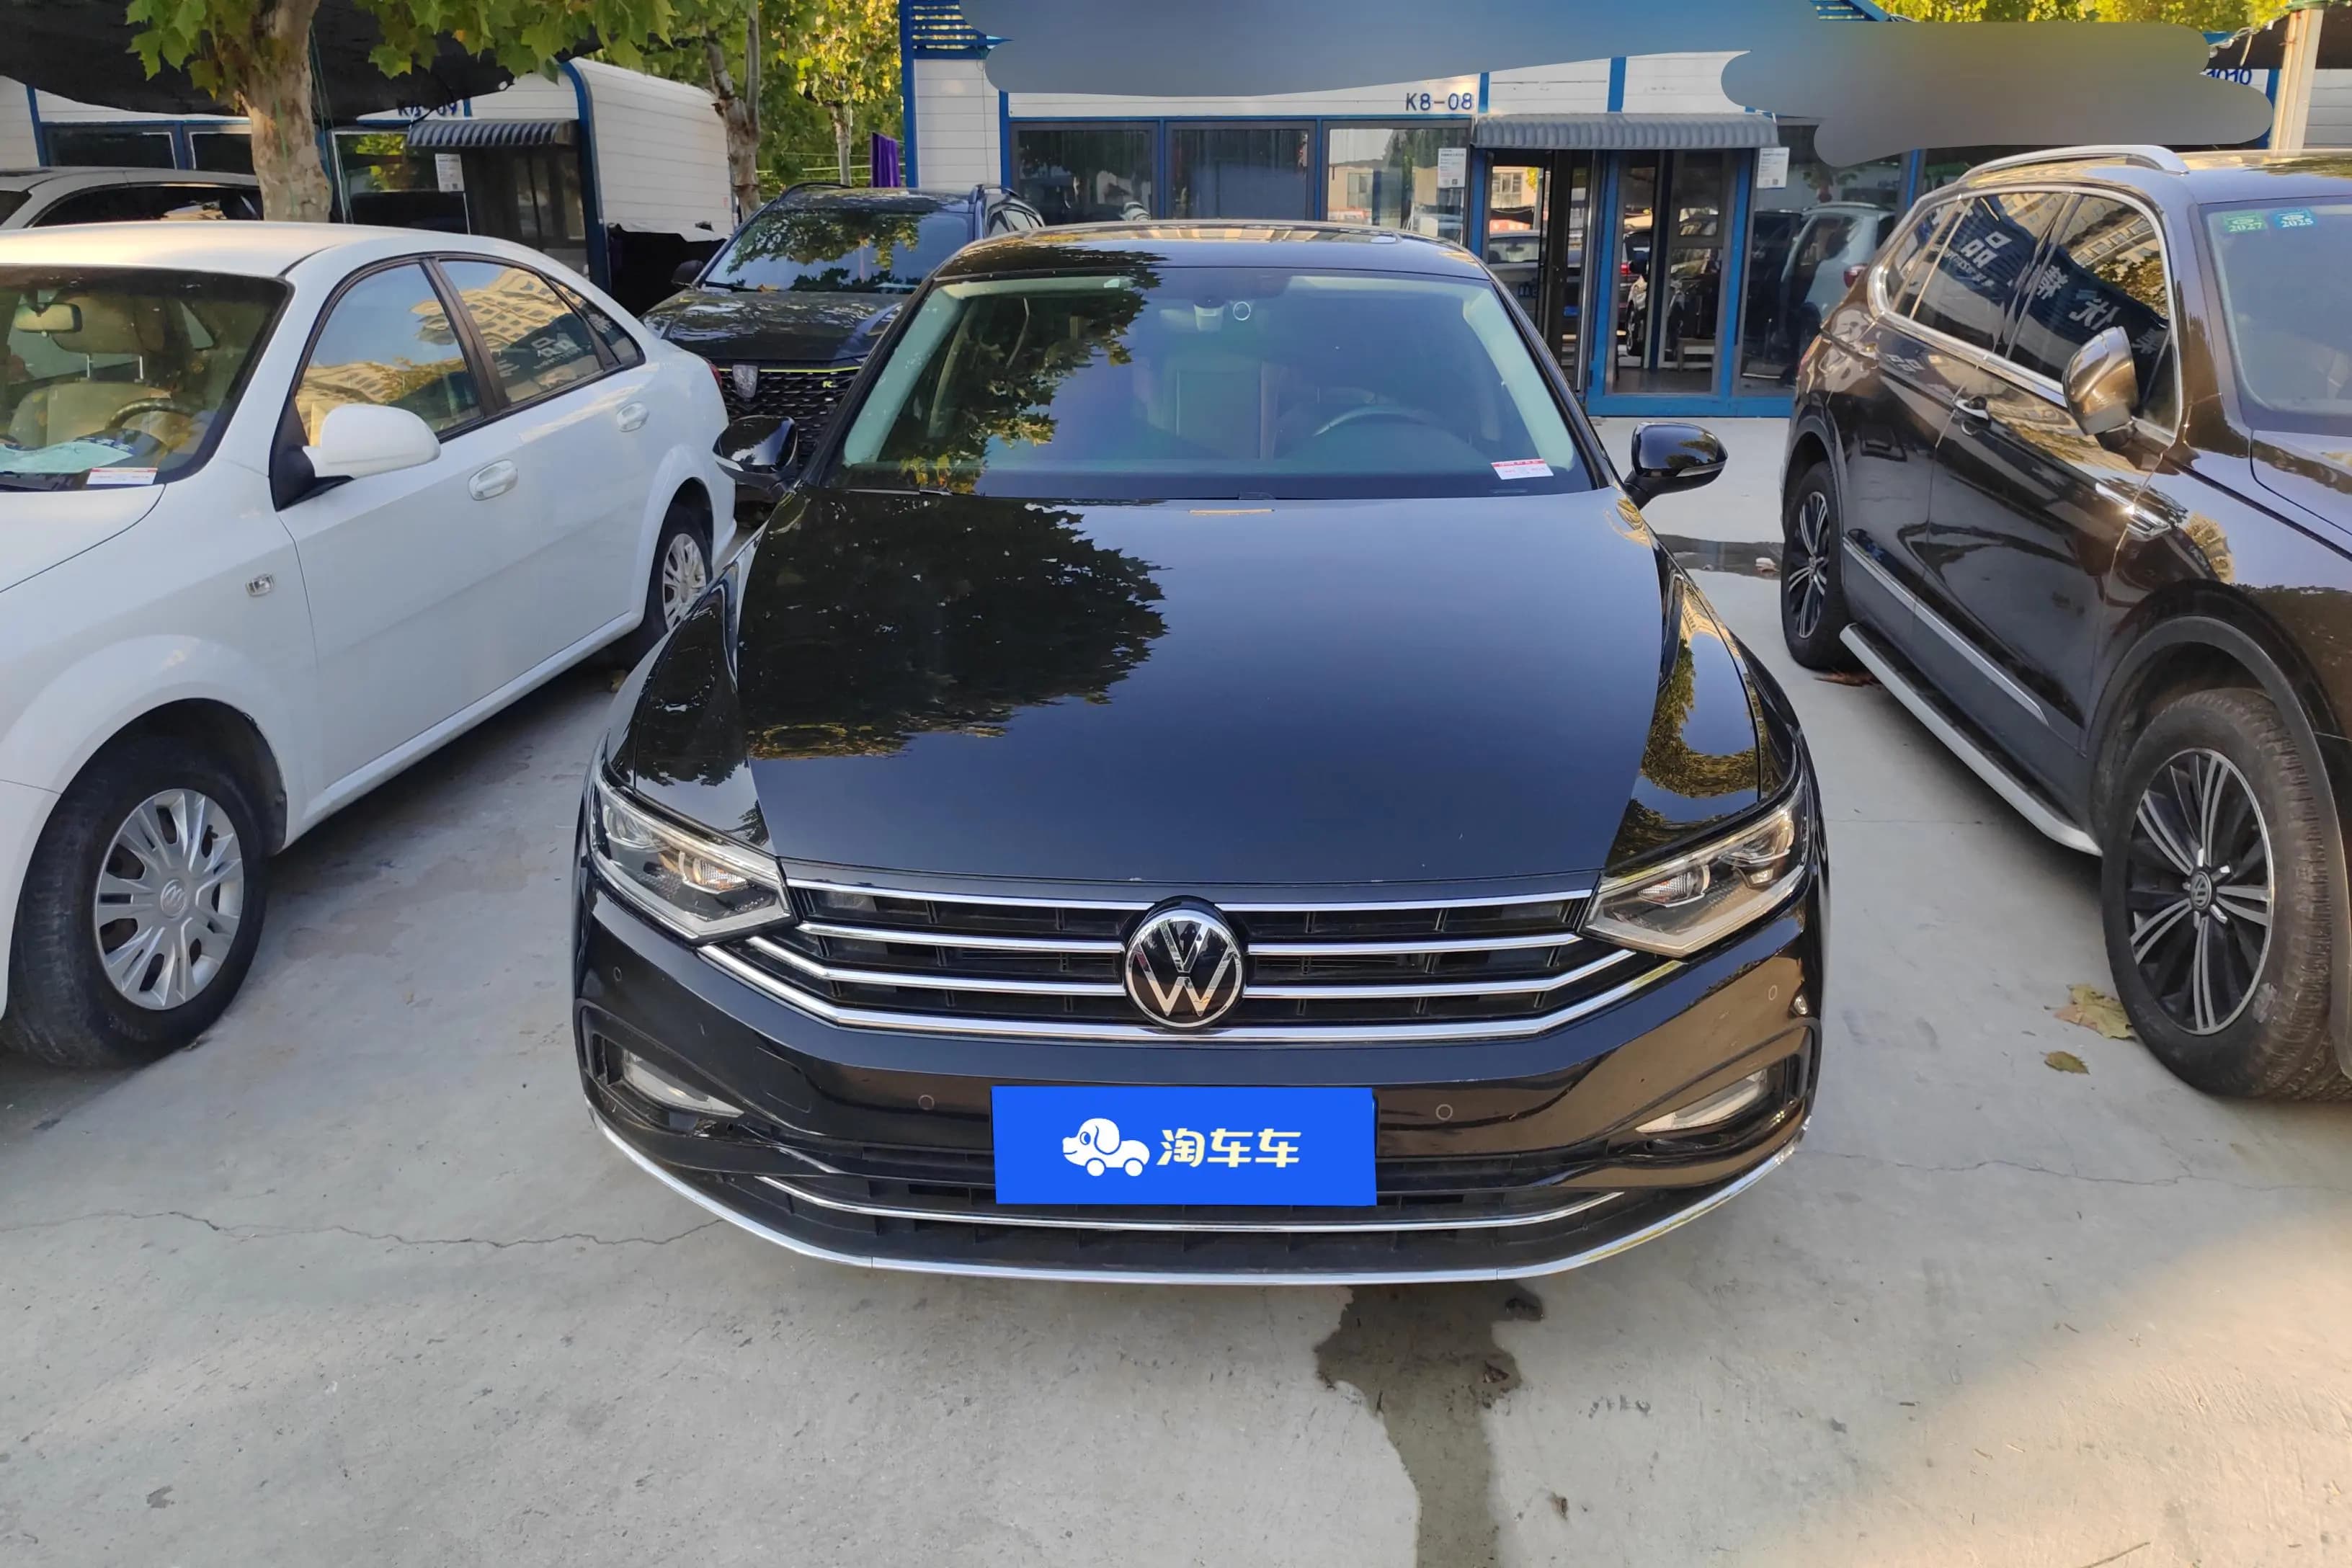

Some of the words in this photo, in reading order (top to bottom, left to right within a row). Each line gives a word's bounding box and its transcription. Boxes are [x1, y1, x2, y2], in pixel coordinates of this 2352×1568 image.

[1405, 92, 1472, 111] K8-08
[2228, 222, 2263, 232] 2027
[2281, 218, 2314, 228] 2025
